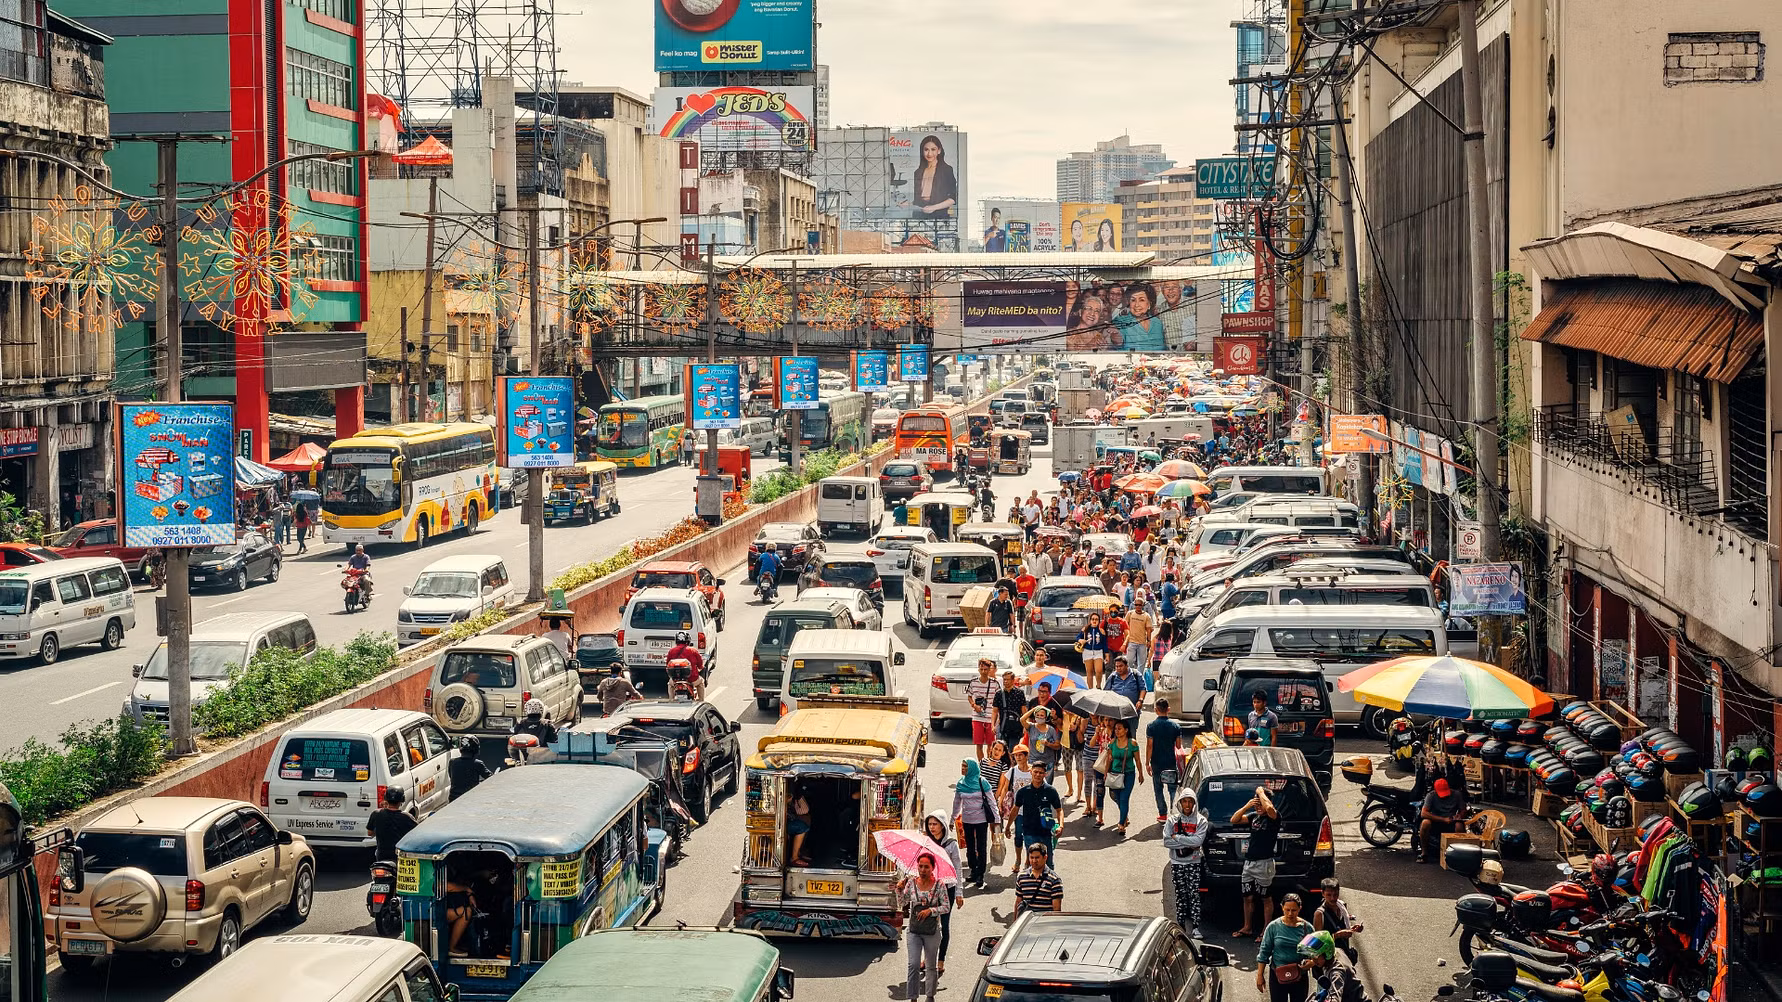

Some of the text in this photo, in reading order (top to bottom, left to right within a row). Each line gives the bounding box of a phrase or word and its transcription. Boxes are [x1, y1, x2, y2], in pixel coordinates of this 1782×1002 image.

[719, 51, 758, 59] Donut
[675, 96, 684, 112] I
[716, 91, 787, 117] JED'S
[787, 127, 806, 140] 24
[1199, 186, 1229, 194] HOTEL &
[972, 288, 993, 296] Huwag
[967, 306, 1063, 318] May RiteMED ba nito?
[1222, 316, 1274, 328] PAWNSHOP
[163, 414, 220, 425] Franchise
[149, 428, 187, 443] SNOW
[181, 437, 209, 448] MAN
[915, 447, 927, 455] MA
[928, 447, 947, 455] ROSE
[164, 527, 202, 536] 563 1408
[152, 535, 212, 545] 0927 011 8000
[1466, 575, 1507, 586] NAZARENO
[286, 818, 333, 830] UV Express Service
[405, 859, 417, 867] 1342
[810, 882, 840, 892] TWZ 122
[740, 910, 899, 940] ARTHUR
